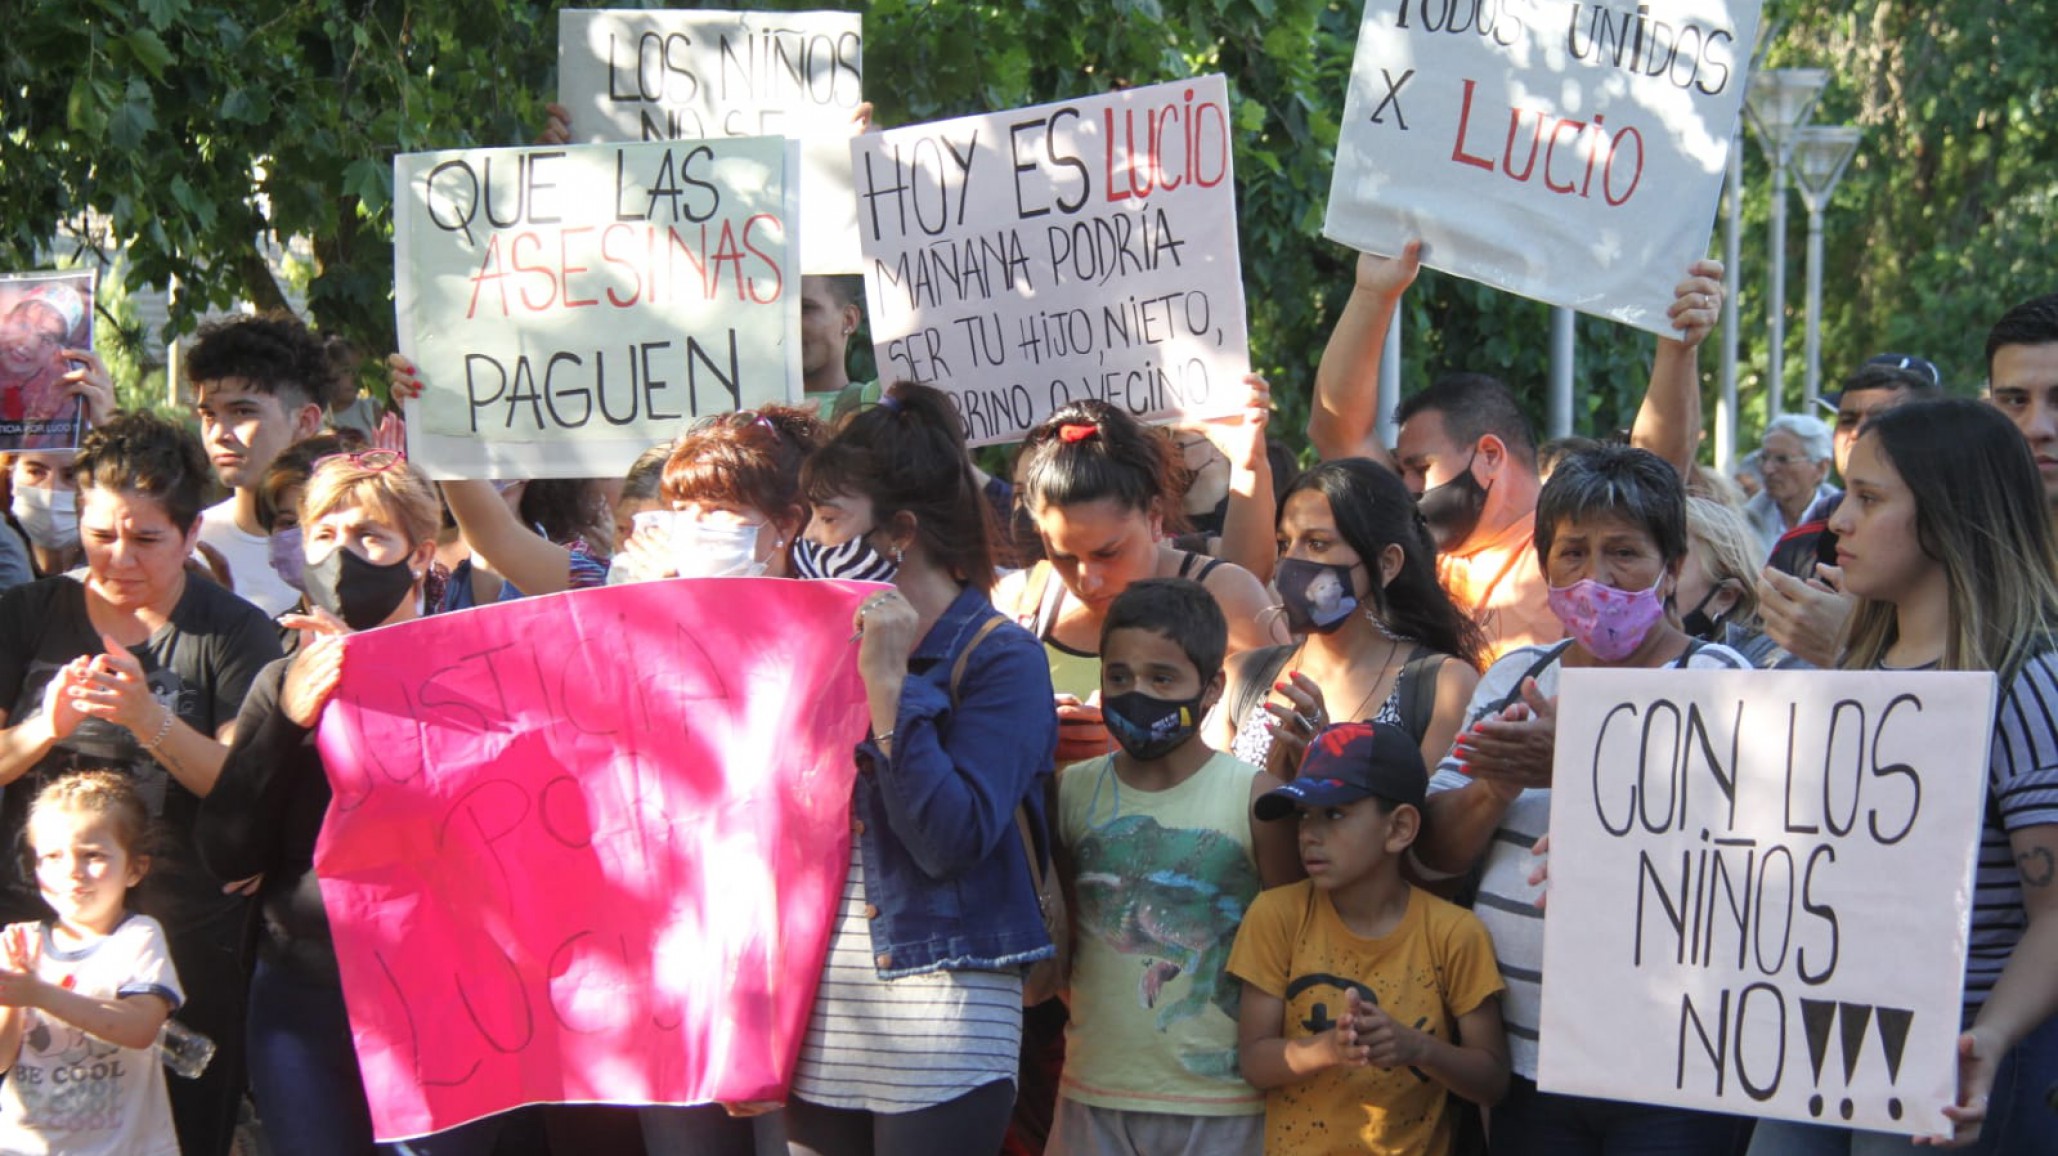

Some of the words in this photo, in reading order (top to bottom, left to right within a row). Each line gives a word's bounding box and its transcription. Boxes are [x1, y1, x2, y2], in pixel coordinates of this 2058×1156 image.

[609, 31, 697, 104] LOS
[720, 27, 861, 108] NIÑOS
[1568, 3, 1733, 96] UNIDOS
[427, 152, 566, 246] QUE
[615, 145, 719, 223] LAS
[863, 129, 978, 241] HOY
[1010, 107, 1091, 219] ES
[466, 213, 783, 319] ASESINAS
[874, 229, 1032, 318] MAÑANA
[1048, 203, 1185, 288] PODRÍA
[465, 328, 741, 432] PAGUEN
[888, 326, 952, 384] SER
[953, 312, 1004, 369] TU
[336, 612, 730, 813] JUSTICIA
[1592, 698, 1744, 837] CON
[1784, 693, 1922, 845] LOS
[1634, 828, 1839, 985] NIÑOS
[374, 926, 681, 1087] LUC
[16, 1066, 42, 1085] BE
[51, 1061, 126, 1084] COOL
